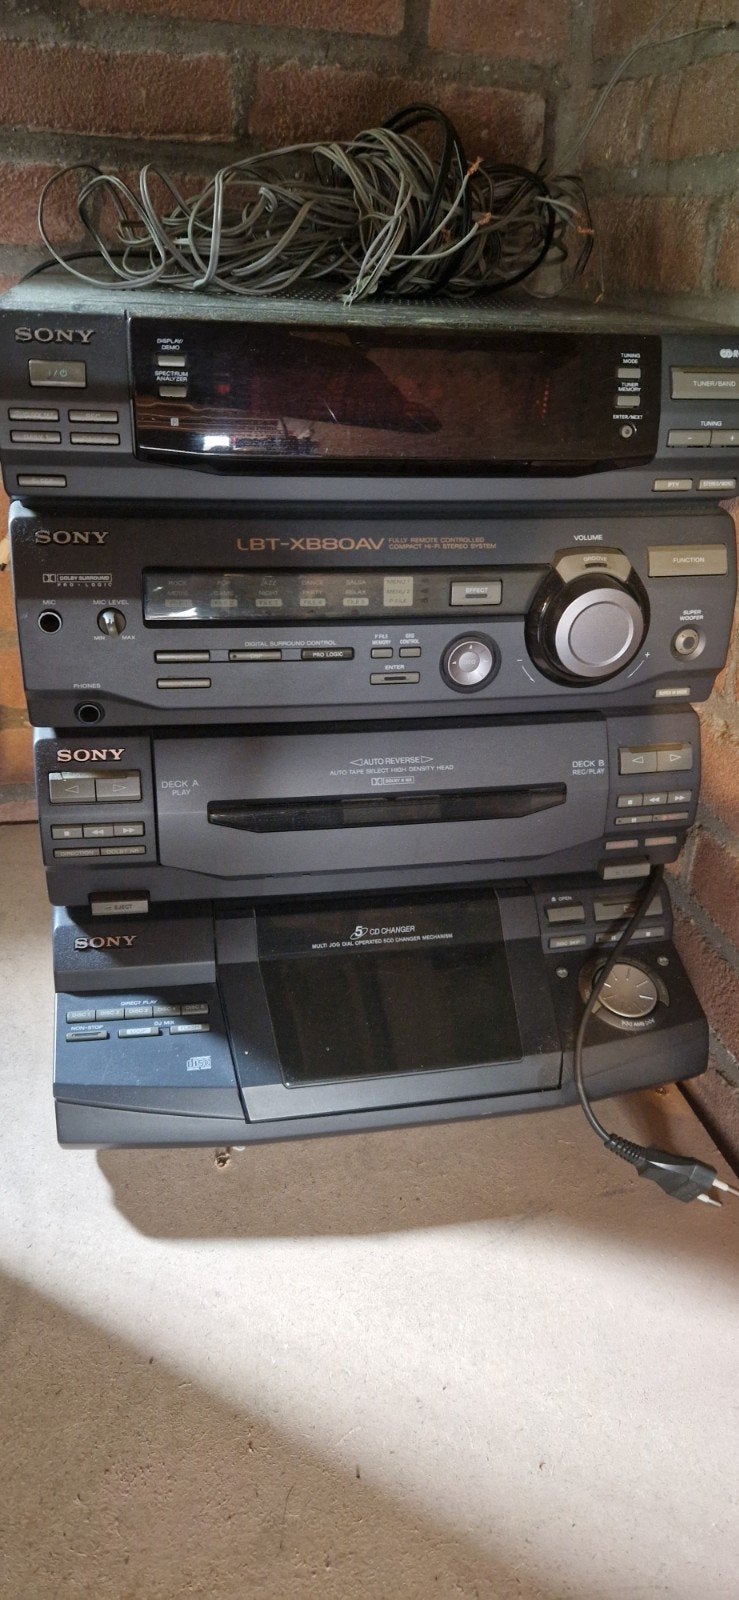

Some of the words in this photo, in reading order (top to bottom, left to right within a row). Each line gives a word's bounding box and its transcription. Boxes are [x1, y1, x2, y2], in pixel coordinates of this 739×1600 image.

[14, 326, 96, 344] SONY
[154, 370, 189, 378] SPECTRUM
[155, 375, 188, 383] ANALYZER
[692, 380, 737, 388] TUNER/BAND
[700, 420, 723, 428] TUNING
[34, 529, 109, 544] SONY
[236, 537, 386, 551] LBT-XB80AV
[583, 554, 608, 562] GROOVE
[672, 556, 705, 564] FUNCTION
[679, 614, 704, 622] WOOFER
[57, 748, 125, 762] SONY
[385, 756, 421, 765] REVERSE
[571, 760, 595, 768] DECK
[598, 759, 605, 767] B
[571, 767, 606, 776] REC/PLAY
[161, 780, 188, 789] DECK
[191, 779, 200, 787] A
[171, 788, 191, 796] PLAY
[113, 903, 133, 911] EJECT
[354, 925, 363, 937] 5
[369, 927, 380, 936] CD
[380, 925, 416, 935] CHANGER
[73, 935, 137, 950] SONY
[354, 938, 383, 946] OPERATED
[395, 935, 421, 943] CHANGER
[421, 933, 453, 941] MECHANISM
